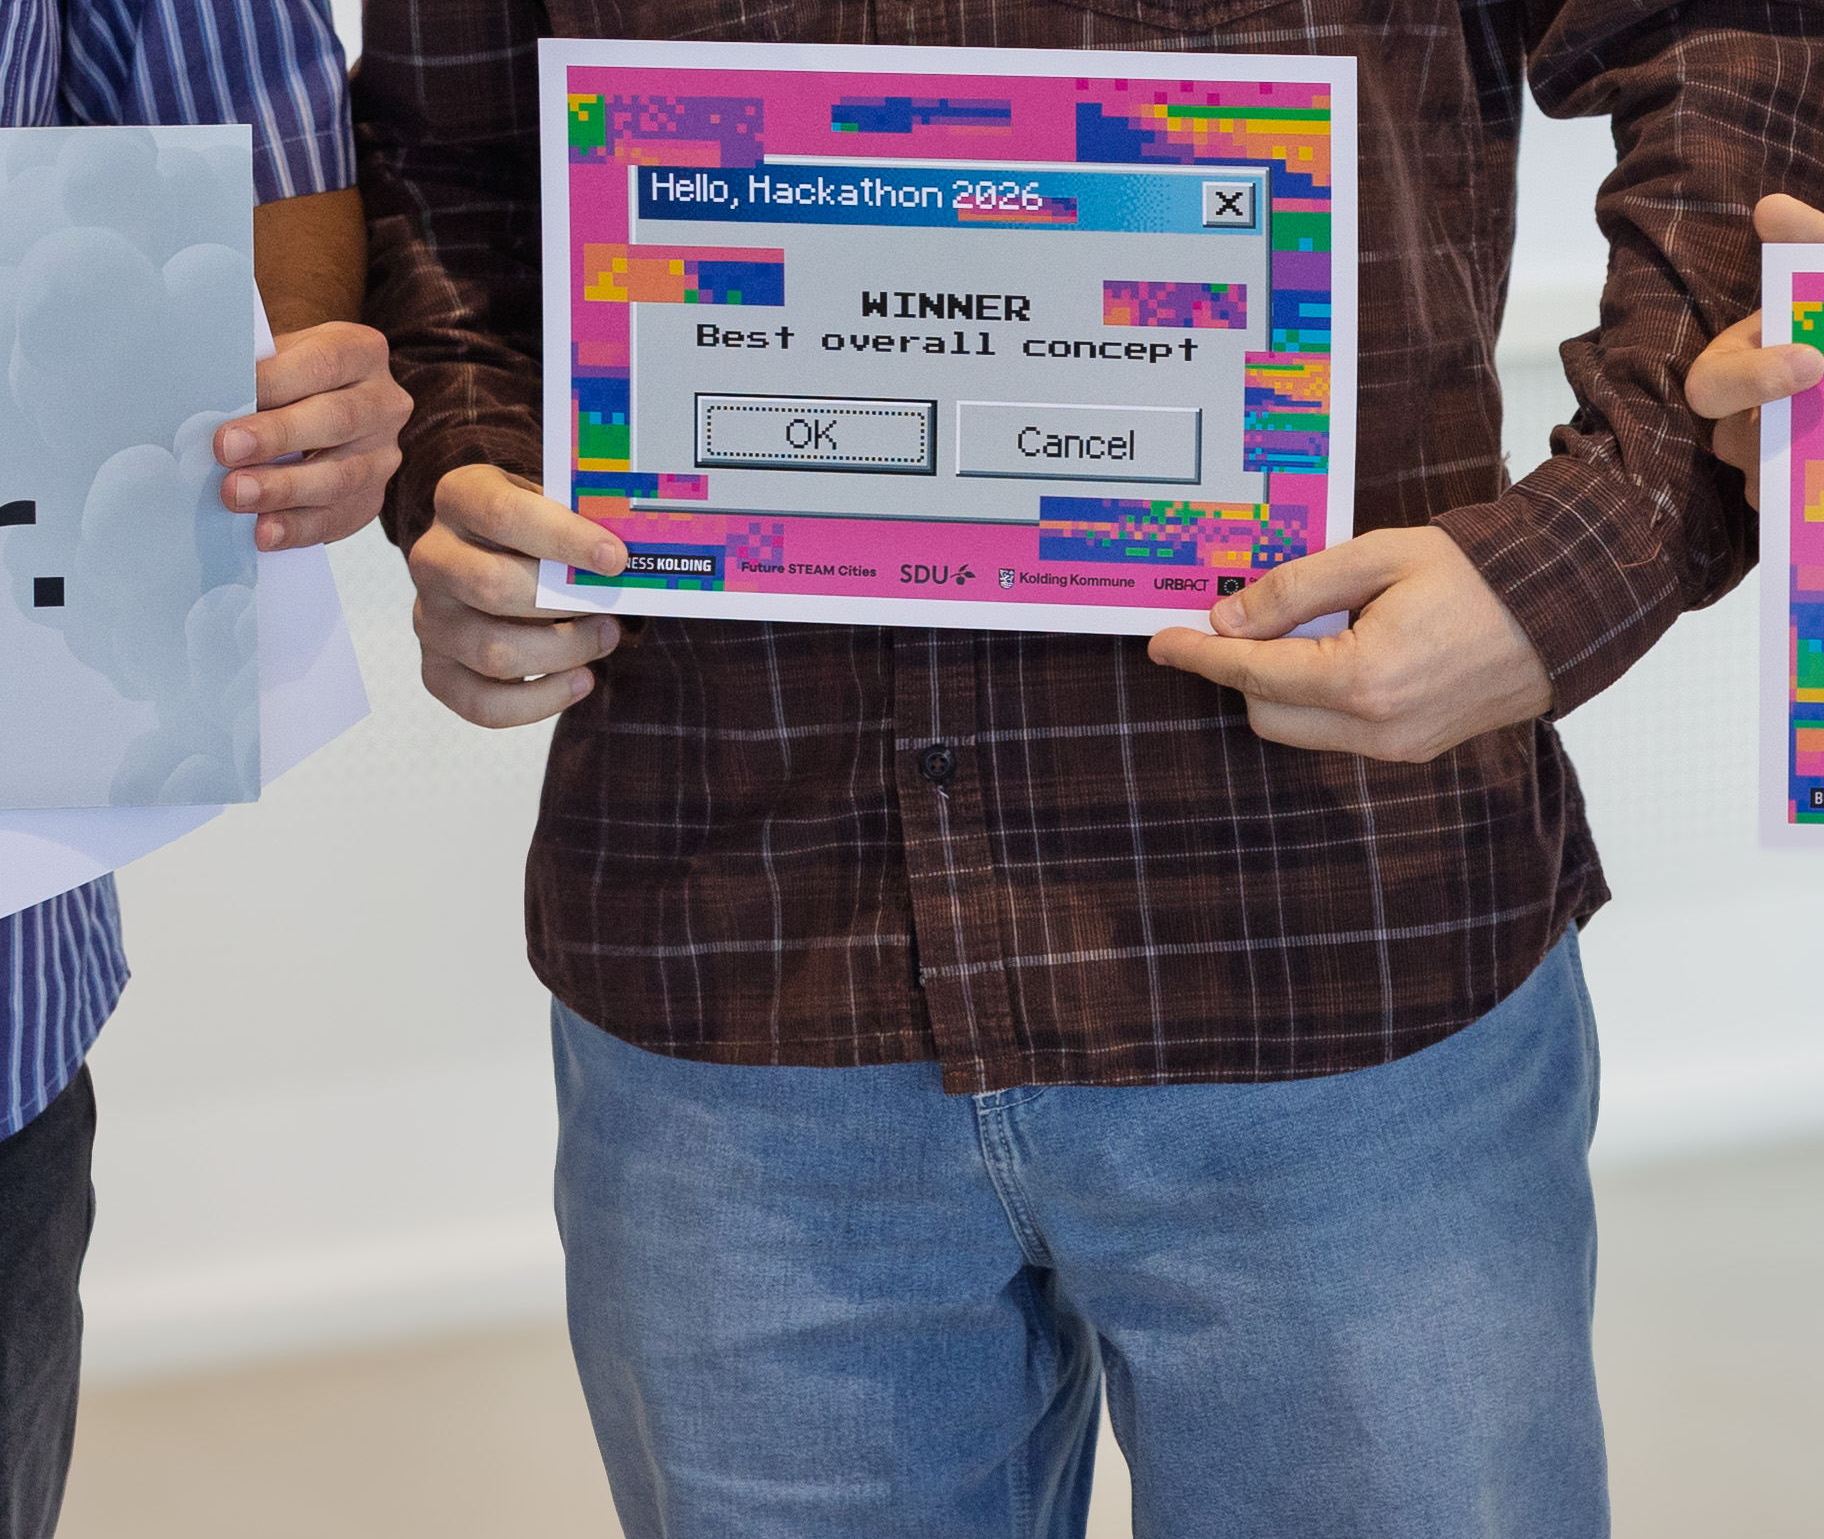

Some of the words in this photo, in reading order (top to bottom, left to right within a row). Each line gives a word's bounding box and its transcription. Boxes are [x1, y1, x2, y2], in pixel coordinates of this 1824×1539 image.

[651, 172, 740, 211] Hello,
[748, 174, 943, 209] Hackathon
[952, 180, 1043, 211] 2026
[861, 290, 1032, 322] WINNER
[696, 323, 795, 350] Best
[821, 330, 996, 357] overall
[1022, 337, 1200, 364] concept
[785, 418, 838, 451] OK
[1017, 426, 1135, 462] Cancel
[627, 556, 655, 571] NESS
[656, 557, 712, 572] KOLDING
[741, 561, 786, 574] Future
[788, 563, 835, 577] STEAM
[837, 564, 877, 578] Cities
[899, 563, 949, 585] SDU
[1019, 571, 1068, 588] Kolding
[1069, 573, 1136, 588] Kommune
[1153, 577, 1210, 592] URBACT
